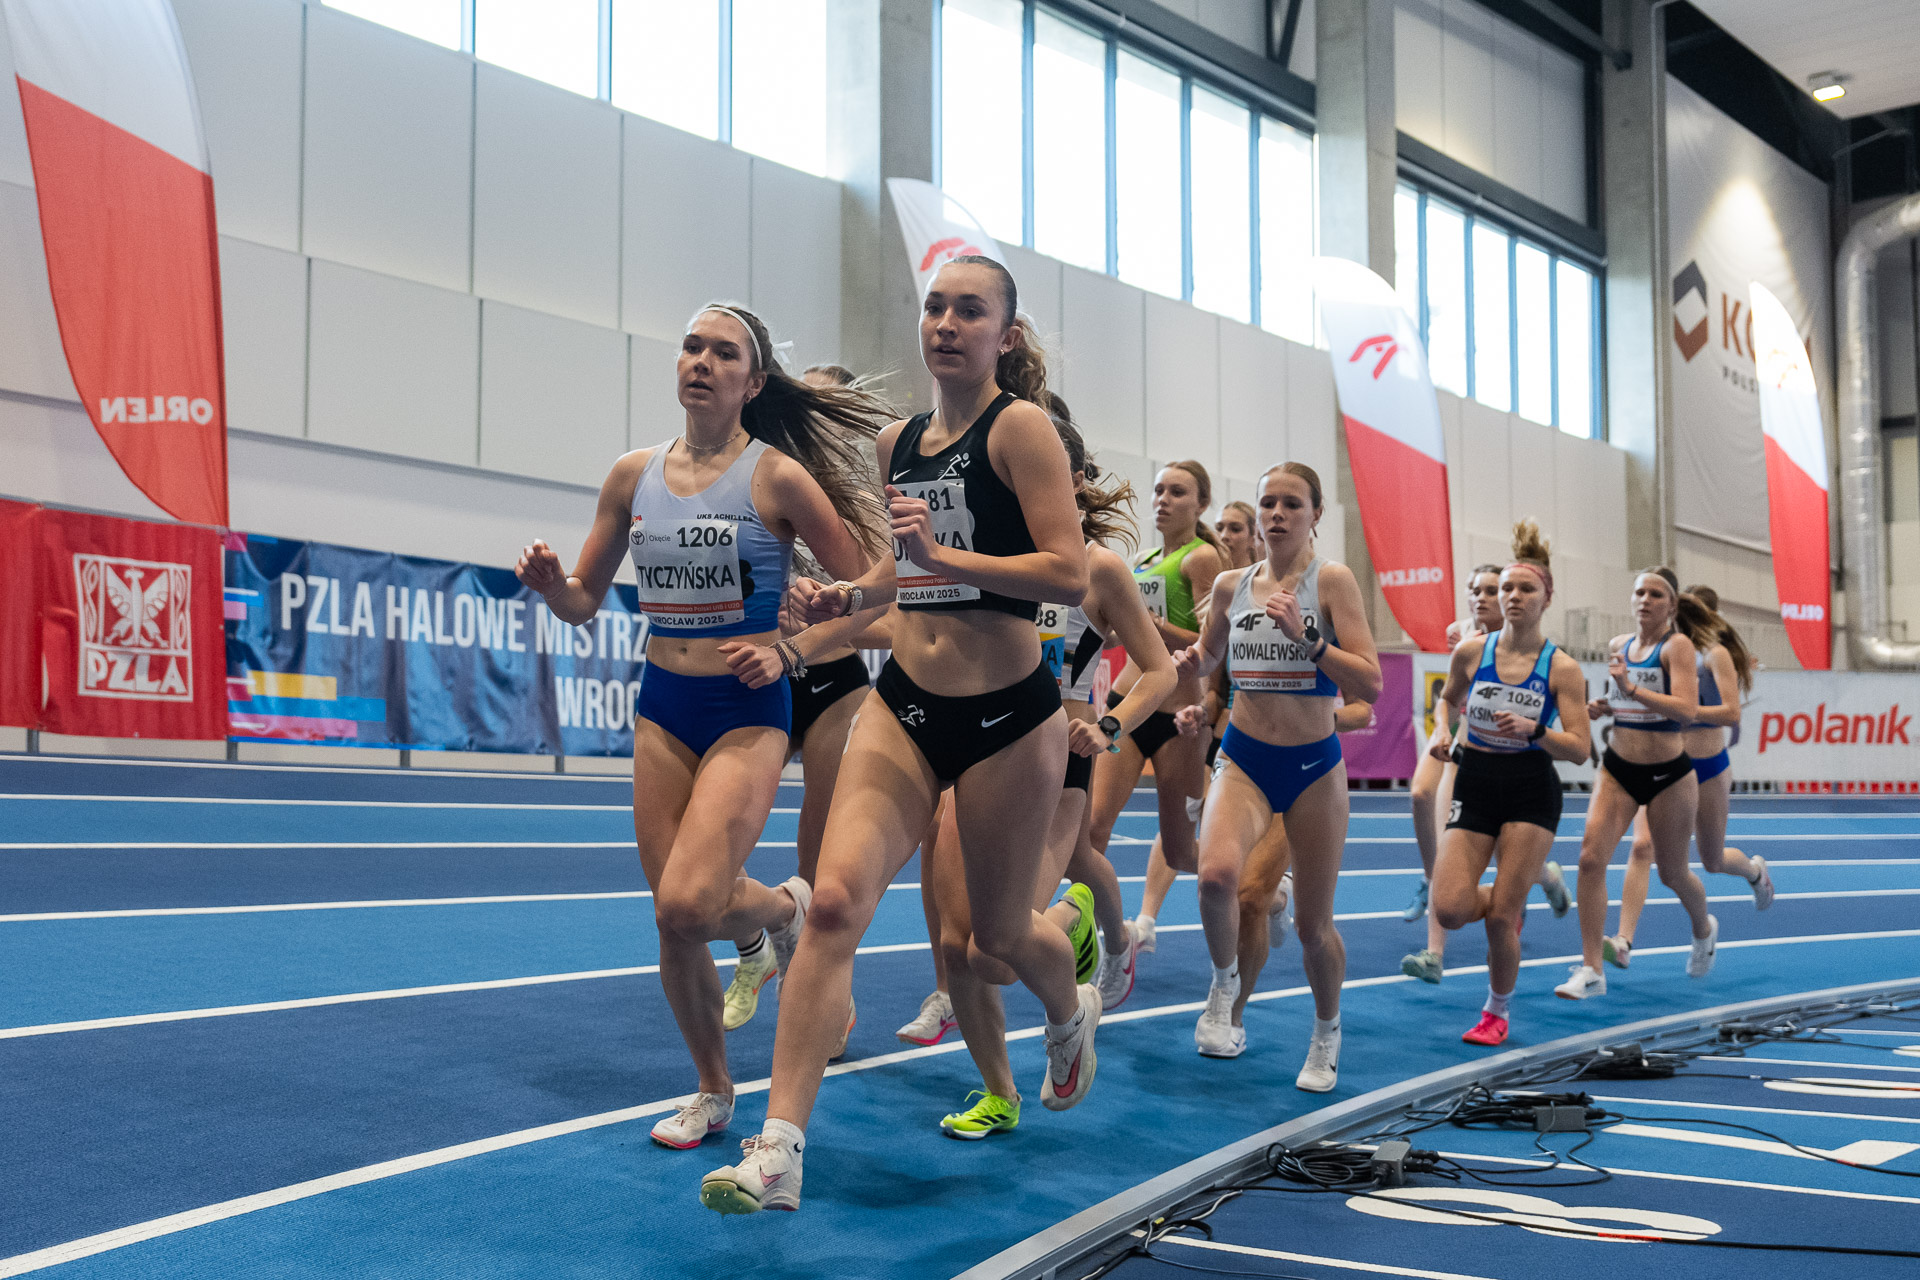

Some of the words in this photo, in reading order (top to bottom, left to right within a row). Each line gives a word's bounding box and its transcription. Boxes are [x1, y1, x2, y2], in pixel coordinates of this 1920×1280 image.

[714, 513, 753, 522] ACHILLES
[648, 534, 671, 543] Okęcie
[676, 526, 733, 548] 1206
[637, 561, 736, 589] TYCZYŃSKA
[936, 588, 961, 598] 2025
[281, 572, 376, 638] PZLA
[386, 584, 526, 653] HALOWE
[535, 602, 651, 662] MISTRZ
[697, 615, 725, 625] 2025
[1236, 613, 1265, 631] 4F
[1232, 642, 1308, 661] KOWALEWSK
[86, 650, 188, 694] PZLA
[1636, 671, 1657, 682] 936
[555, 675, 642, 731] WROC
[1507, 691, 1542, 708] 1026
[1758, 701, 1912, 754] polanik
